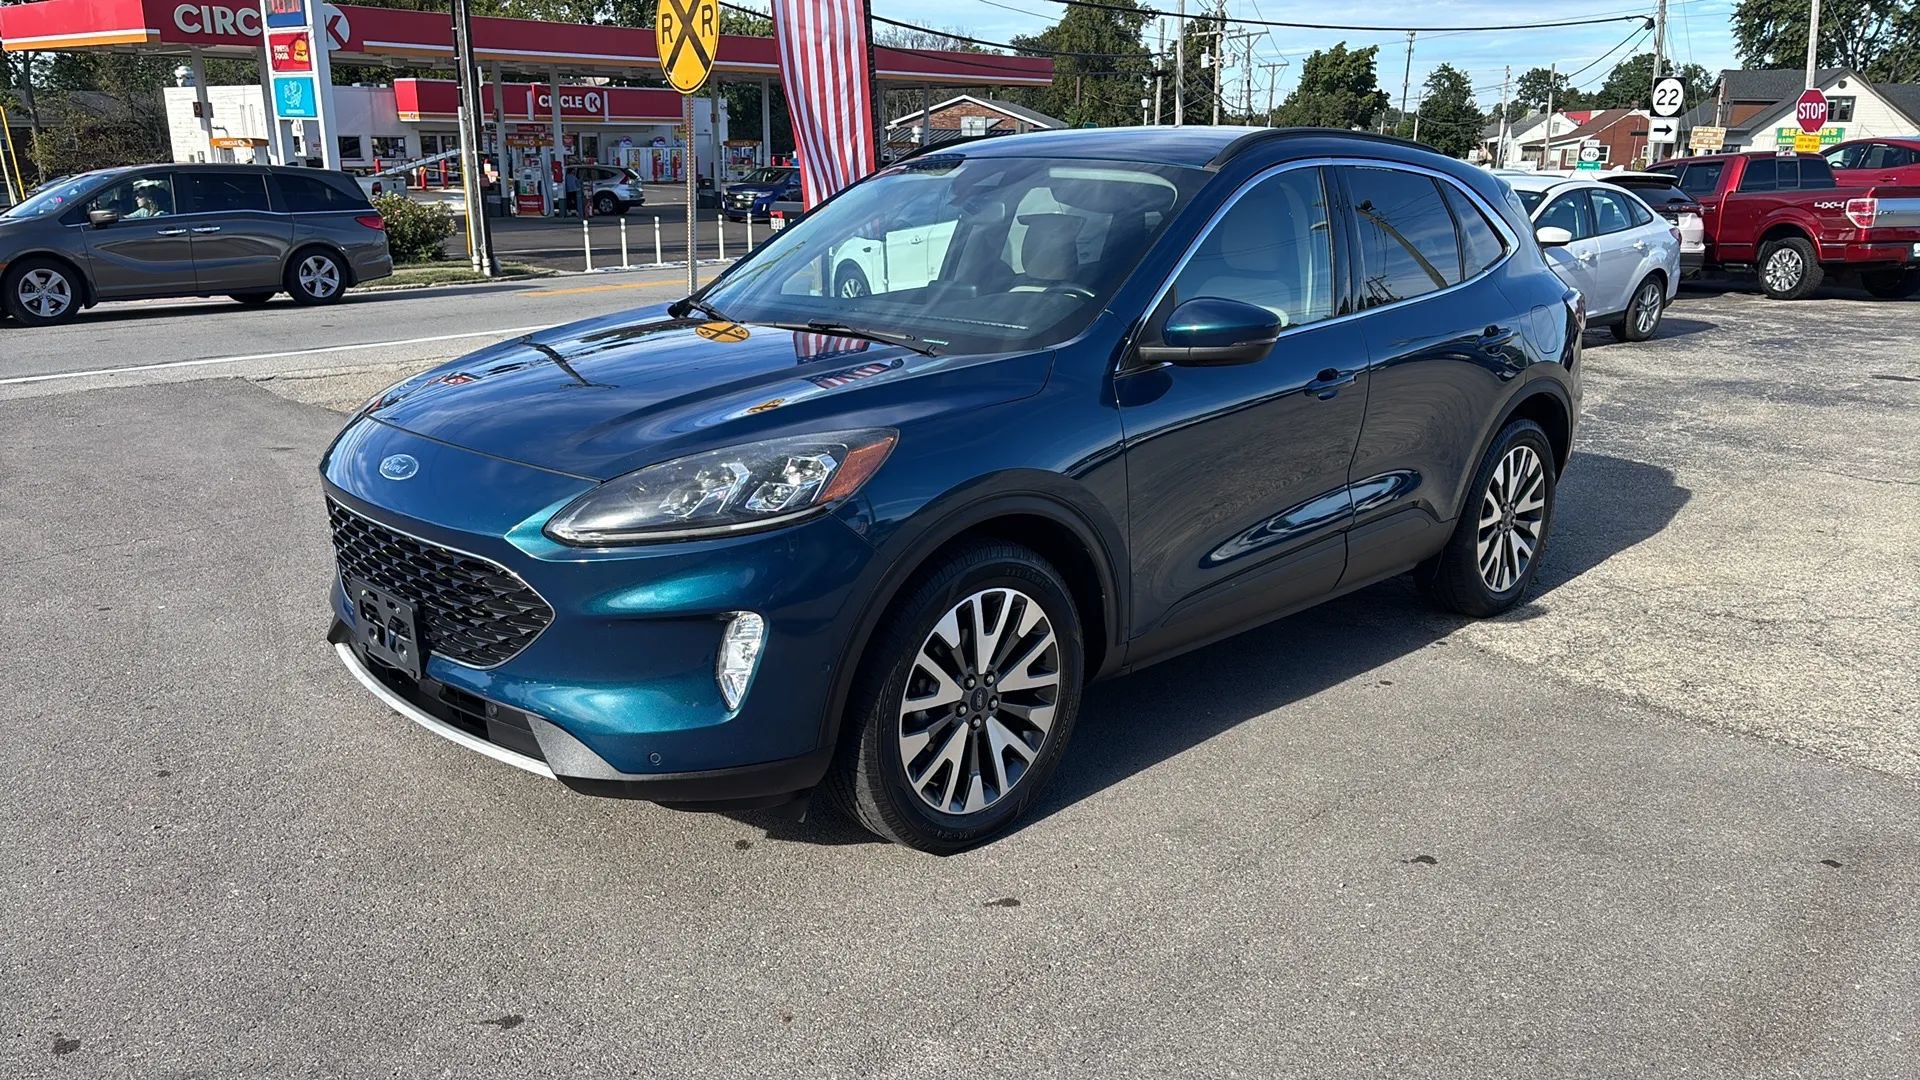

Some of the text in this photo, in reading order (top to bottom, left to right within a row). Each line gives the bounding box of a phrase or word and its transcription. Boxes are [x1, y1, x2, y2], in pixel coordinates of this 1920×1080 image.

[174, 4, 262, 37] CIRC
[539, 95, 582, 108] CICLE
[1656, 88, 1679, 106] 22
[1798, 102, 1826, 120] STOP
[1583, 151, 1597, 159] 146
[383, 457, 409, 474] Ford
